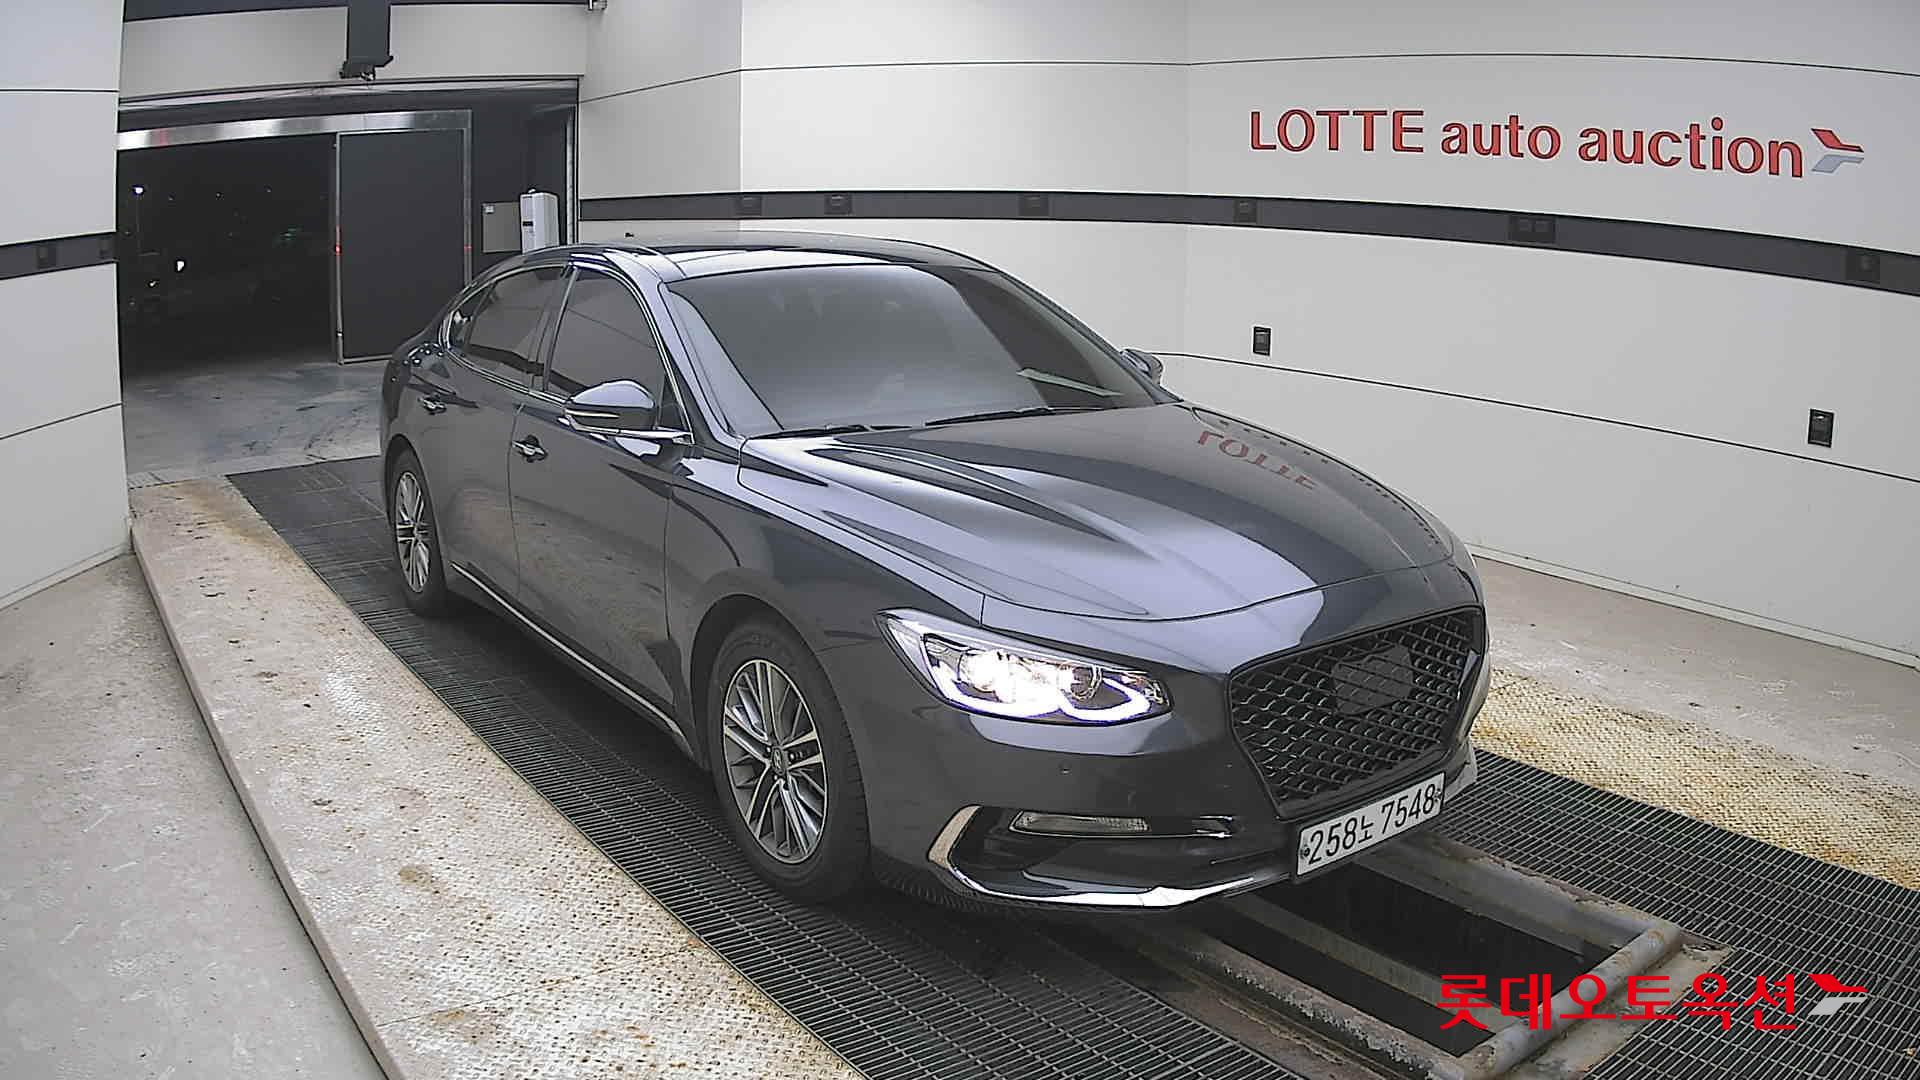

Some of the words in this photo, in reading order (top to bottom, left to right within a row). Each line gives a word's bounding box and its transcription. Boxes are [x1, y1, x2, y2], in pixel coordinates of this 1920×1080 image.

[1250, 109, 1425, 154] LOTTE
[1440, 114, 1562, 160] auto
[1578, 116, 1804, 178] auction
[1308, 815, 1374, 865] 258노
[1381, 783, 1436, 834] 7548
